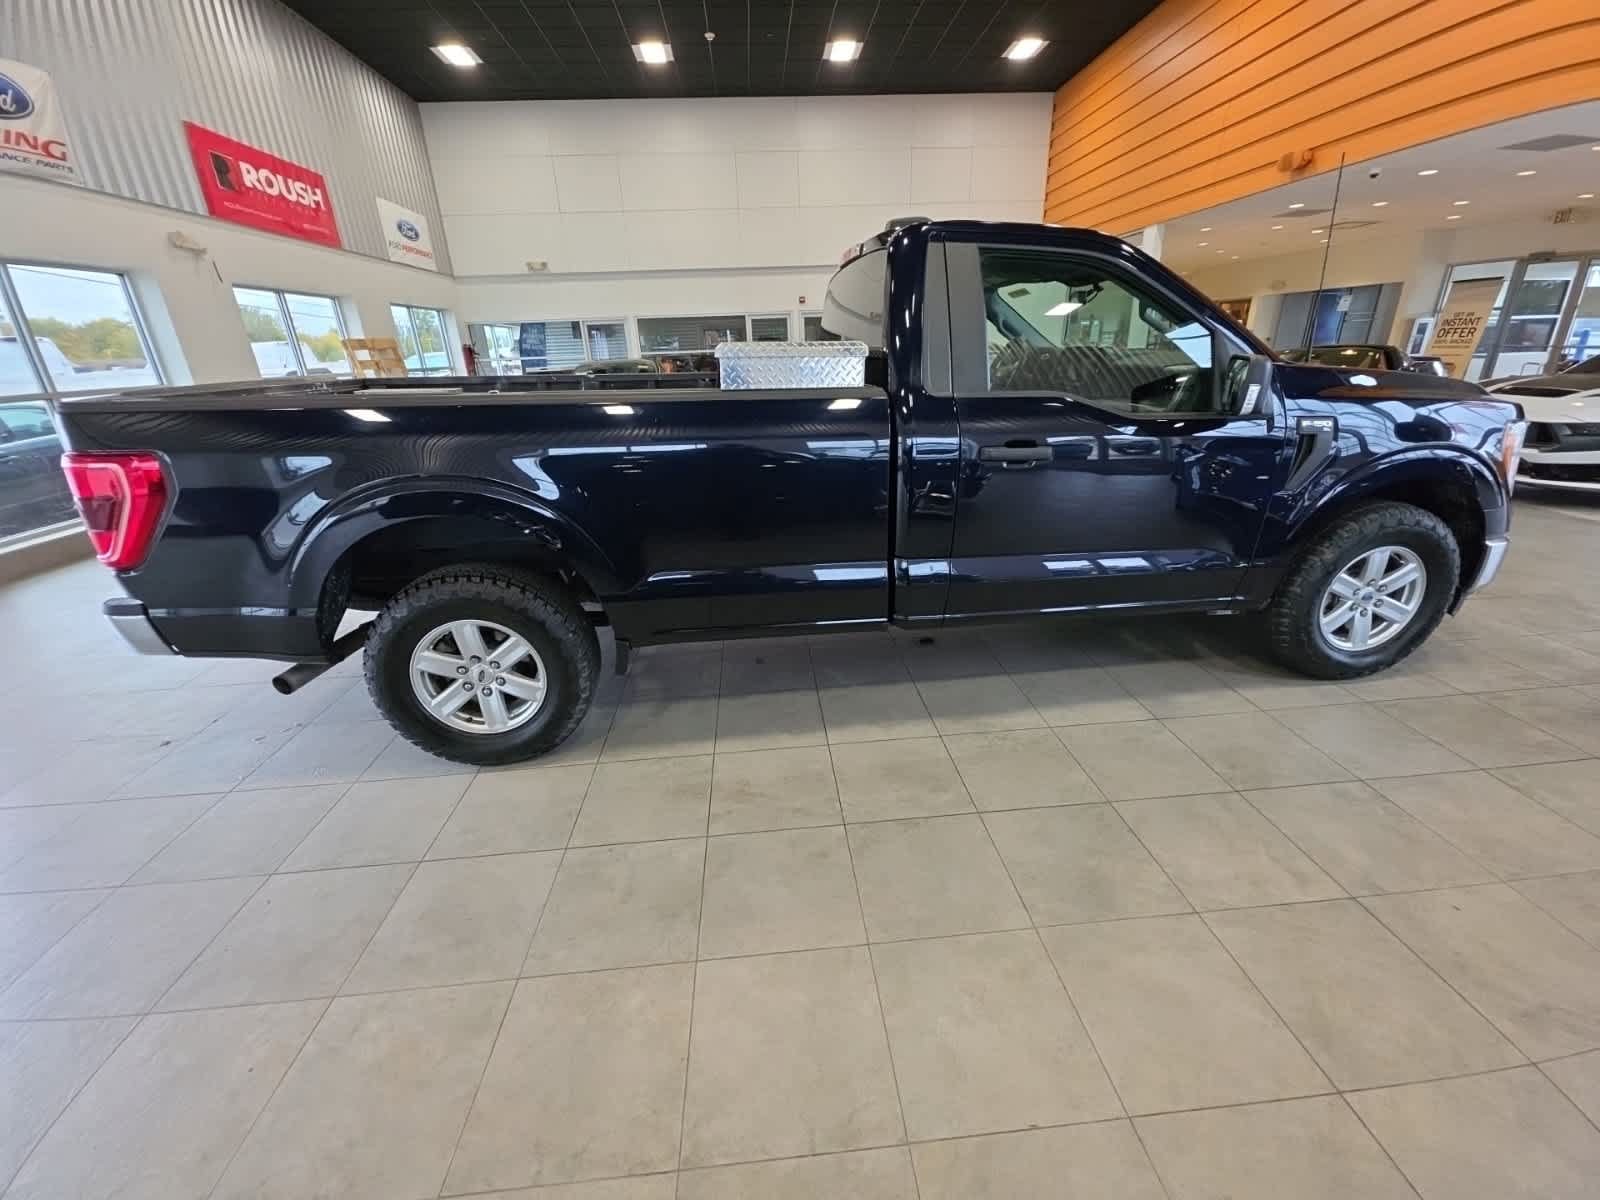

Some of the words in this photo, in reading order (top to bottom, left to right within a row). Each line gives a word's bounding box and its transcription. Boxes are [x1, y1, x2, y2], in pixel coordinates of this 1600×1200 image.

[238, 161, 325, 210] ROUSH
[1441, 316, 1483, 327] INSTANT
[1437, 327, 1477, 338] OFFER
